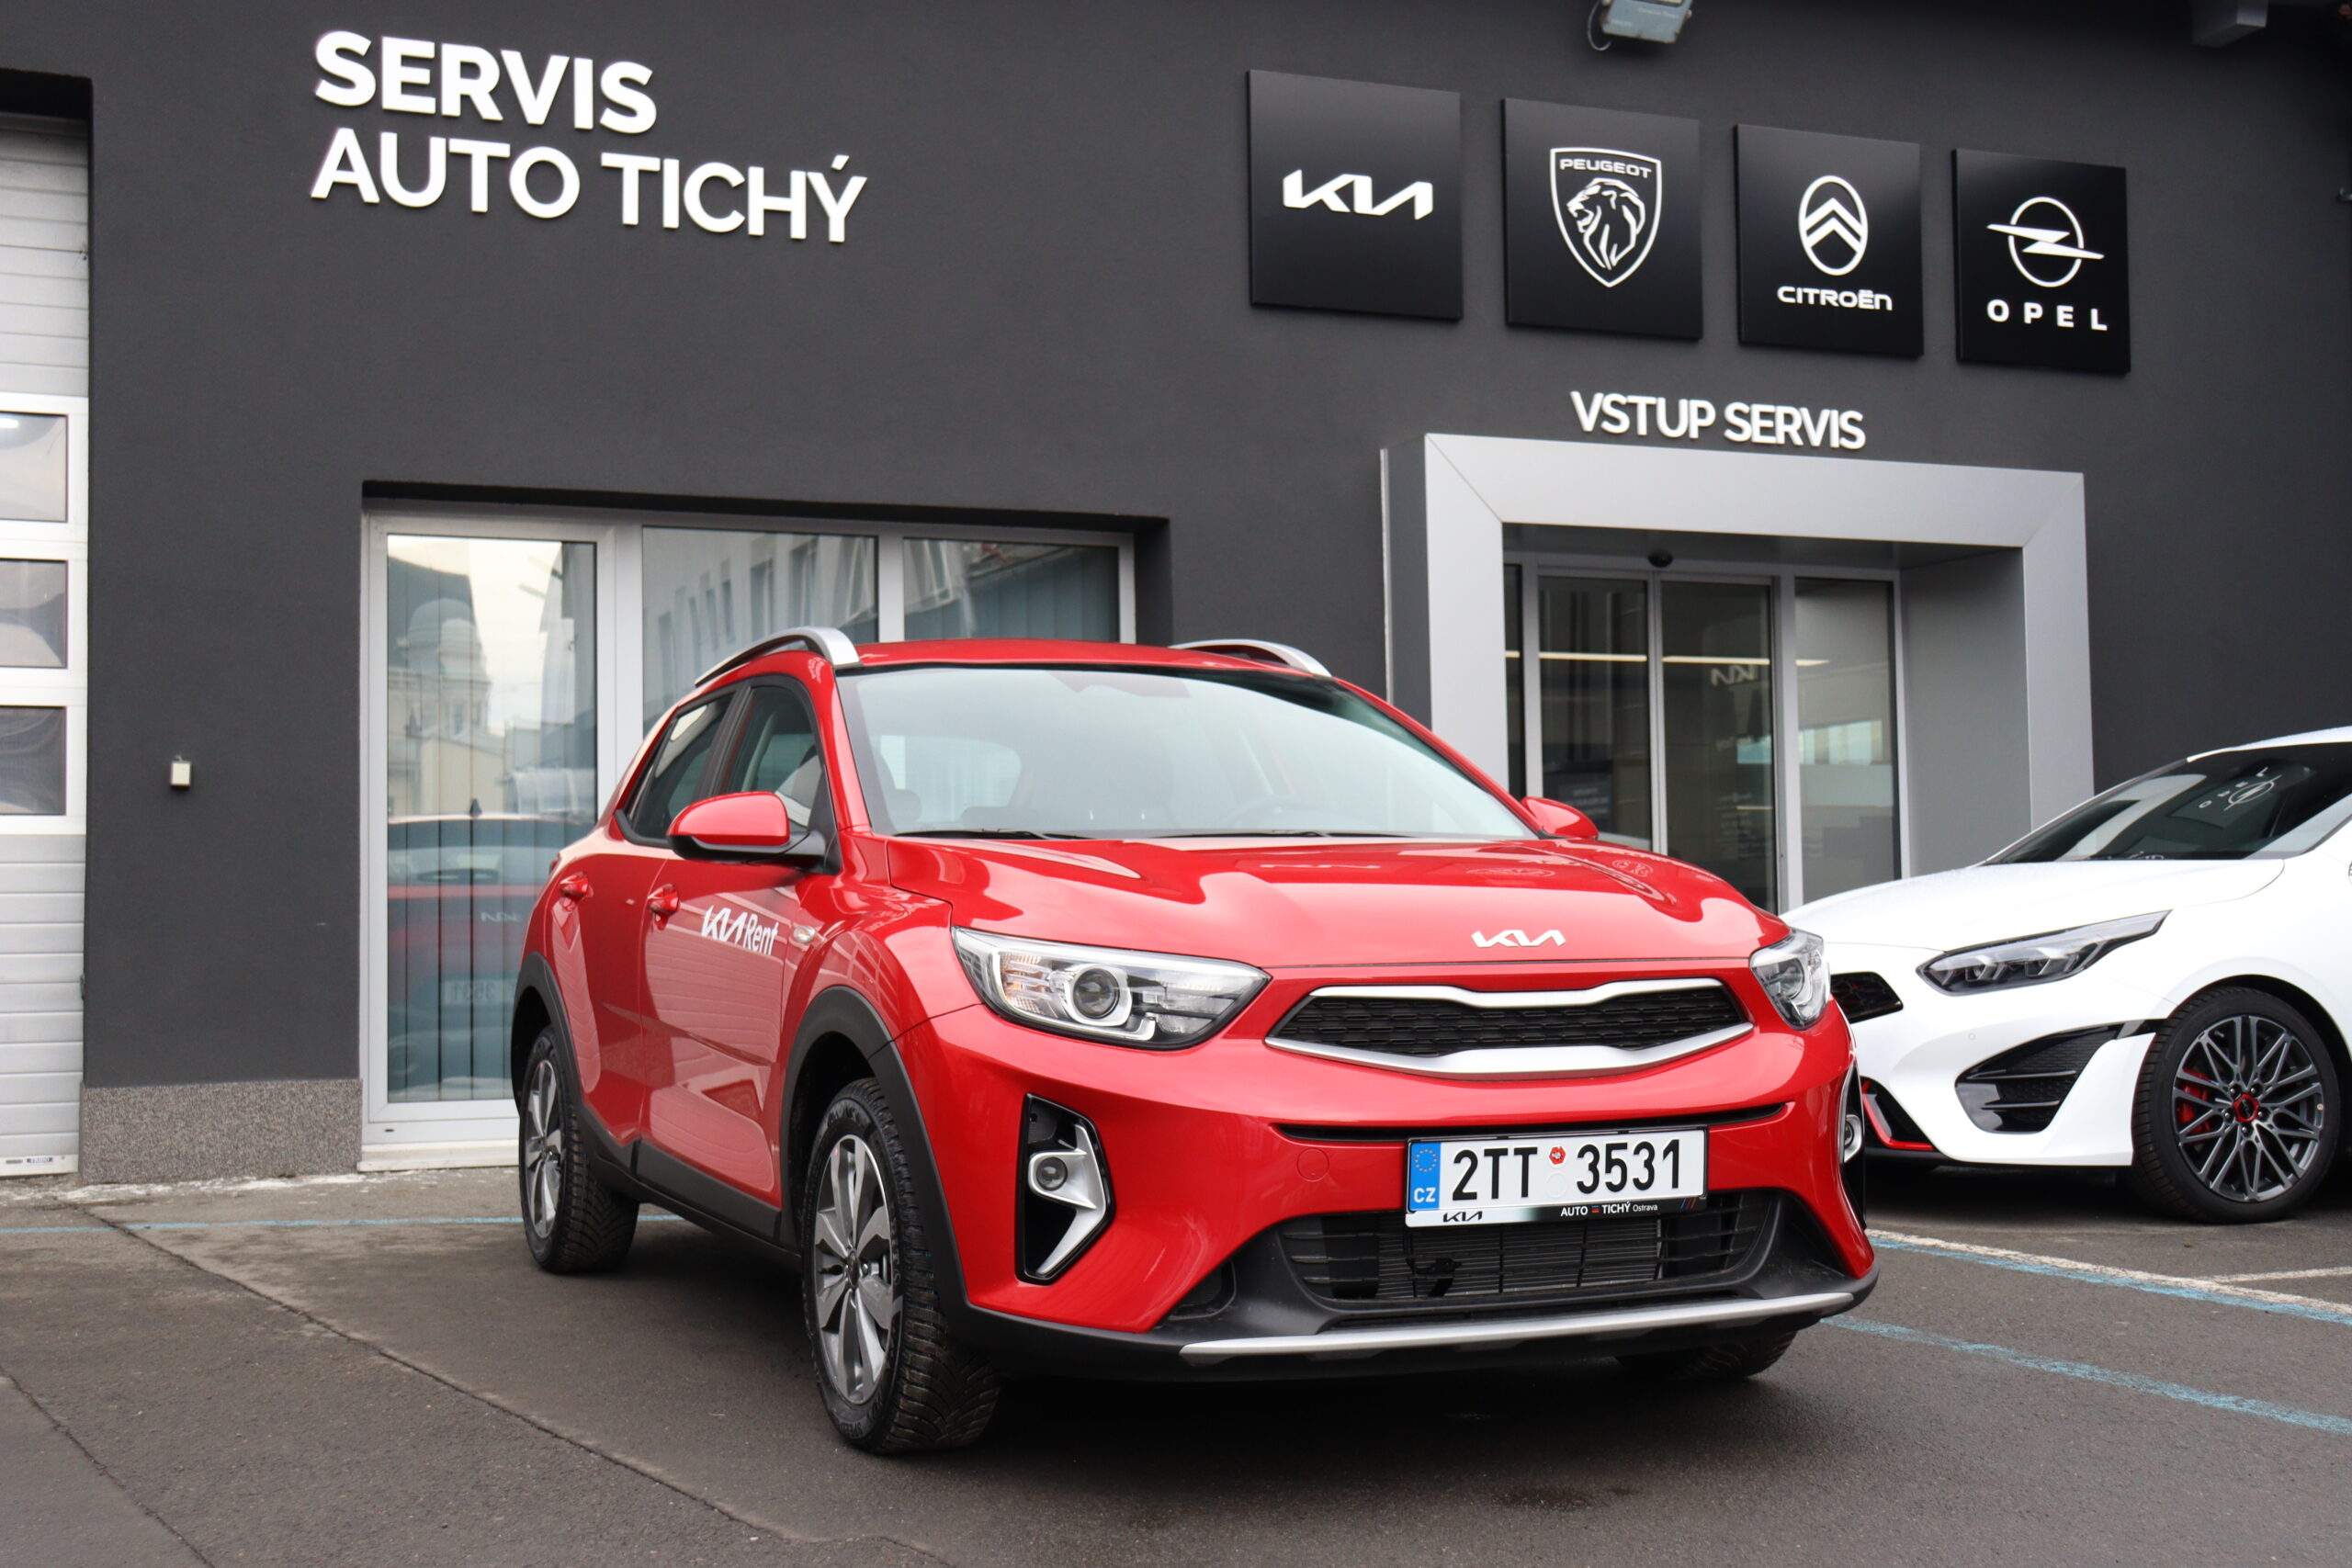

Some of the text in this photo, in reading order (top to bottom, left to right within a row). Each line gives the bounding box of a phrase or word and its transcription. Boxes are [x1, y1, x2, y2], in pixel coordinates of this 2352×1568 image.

[314, 30, 657, 134] SERVIS
[311, 127, 867, 243] AUTO TICHÝ
[1560, 157, 1653, 179] PEUGEOT
[1283, 168, 1433, 220] KIA
[1986, 299, 2108, 332] OPEL
[1570, 390, 1867, 450] VSTUP SERVIS
[701, 905, 779, 955] KIA Rent
[1471, 929, 1566, 948] KIA
[1452, 1139, 1680, 1201] 2TT 3531
[1413, 1187, 1436, 1203] CZ
[1560, 1201, 1658, 1217] AUTO TICHÝ Ostrava
[1442, 1210, 1483, 1223] KIA
